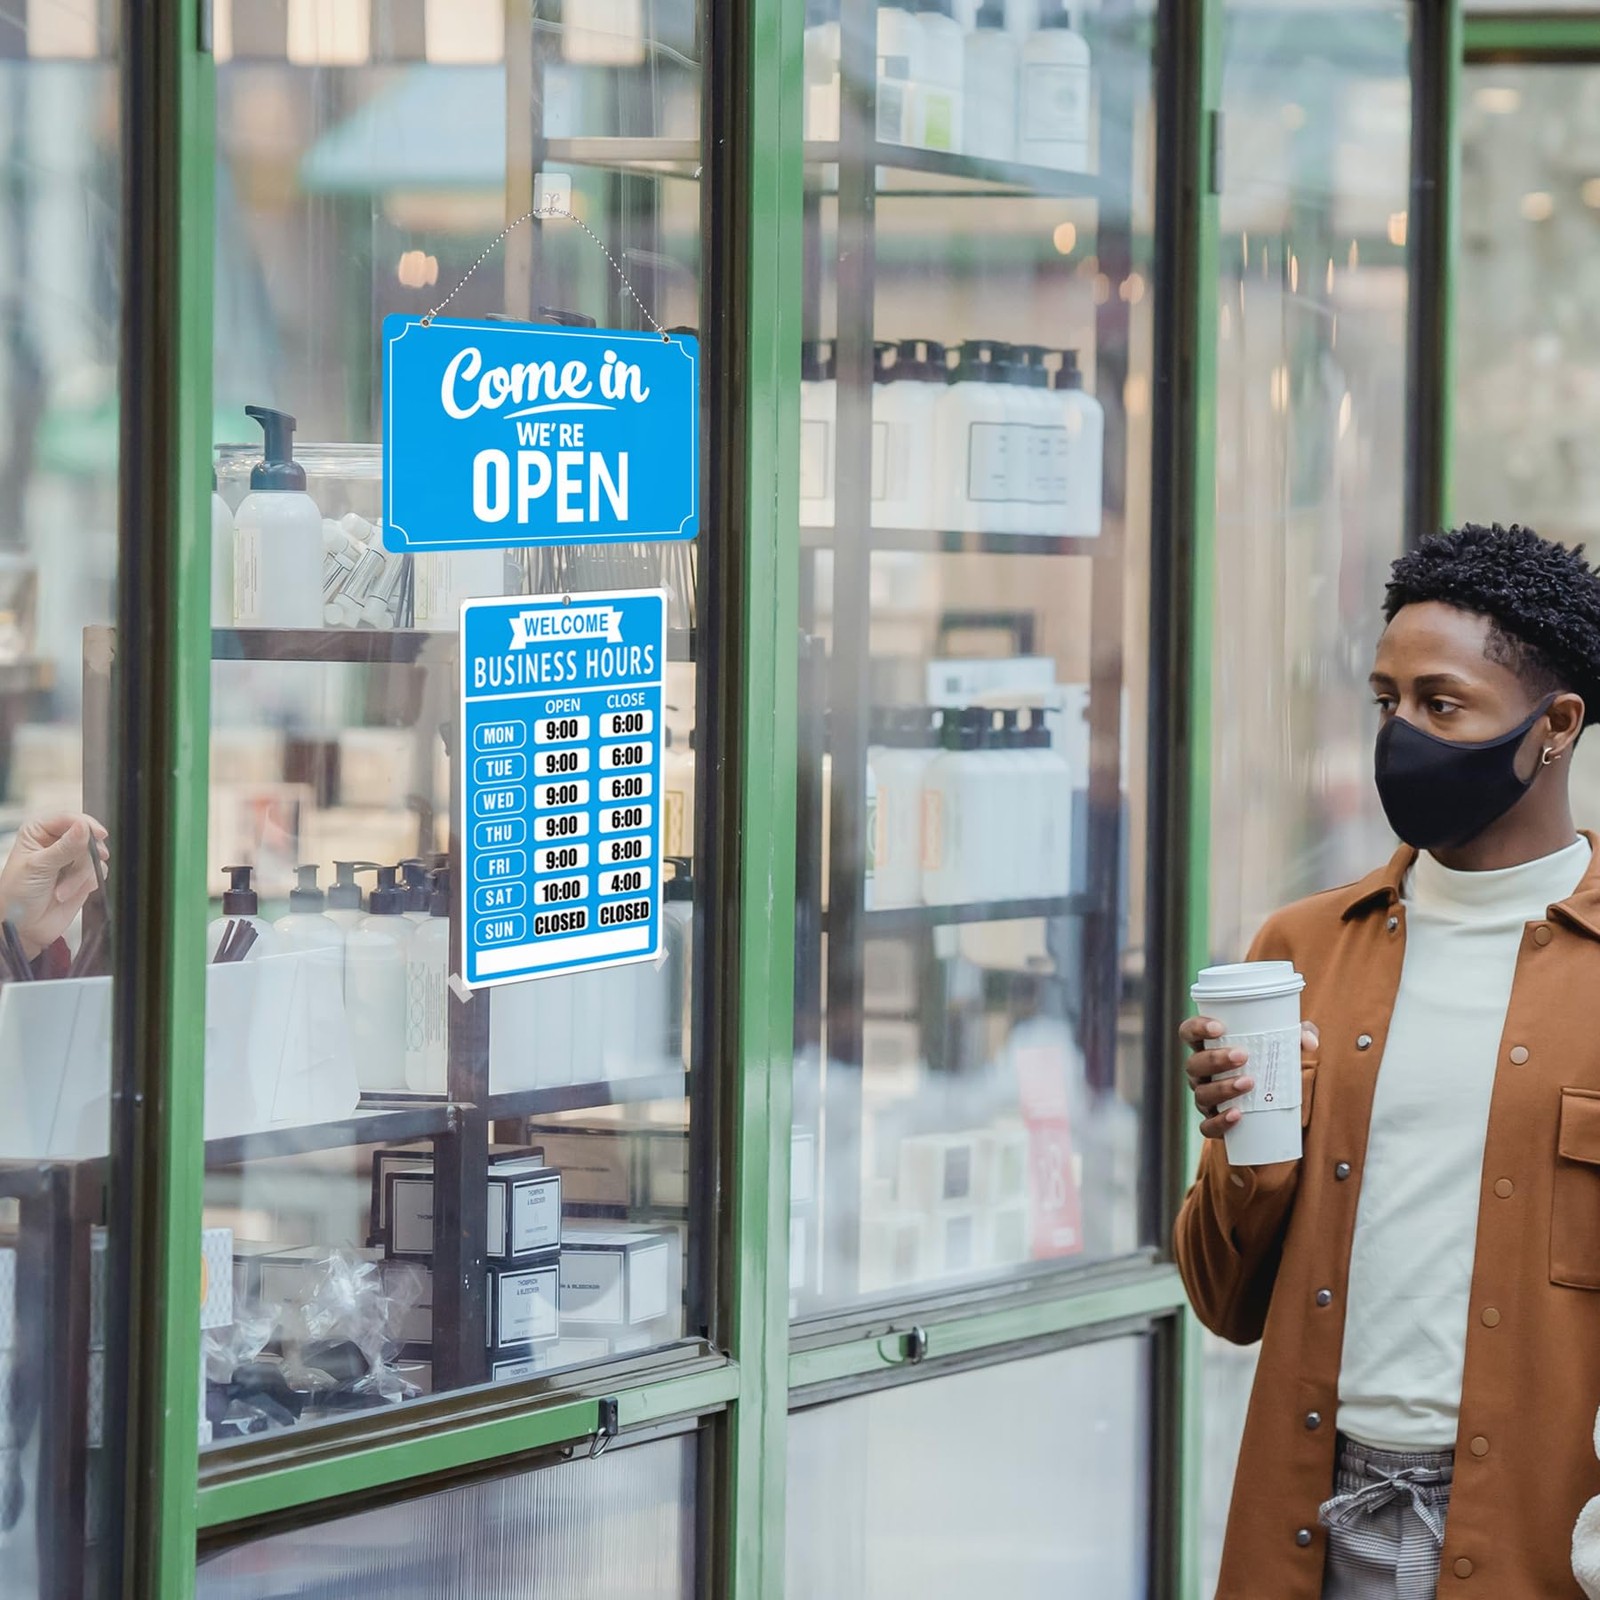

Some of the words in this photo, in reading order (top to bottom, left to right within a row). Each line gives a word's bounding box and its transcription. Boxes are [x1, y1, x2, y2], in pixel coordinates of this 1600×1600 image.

[441, 347, 593, 420] Come
[599, 349, 650, 403] in
[516, 422, 584, 447] WE'RE
[473, 448, 628, 524] OPEN
[524, 613, 609, 637] WELCOME
[474, 650, 577, 688] BUSINESS
[586, 644, 654, 679] HOURS
[545, 698, 581, 714] OPEN
[606, 692, 645, 709] CLOSE
[483, 726, 515, 744] MON
[546, 719, 578, 740] 9:00
[612, 713, 643, 734] 6:00
[485, 759, 513, 777] TUE
[546, 752, 578, 773] 9:00
[612, 745, 643, 766] 6:00
[482, 791, 514, 811] WED
[546, 784, 578, 806] 9:00
[612, 777, 643, 798] 6:00
[485, 824, 512, 843] THU
[546, 815, 578, 837] 9:00
[611, 807, 642, 829] 6:00
[488, 857, 511, 876] FRI
[546, 848, 578, 870] 9:00
[611, 839, 642, 861] 8:00
[484, 887, 513, 907] SAT
[542, 880, 581, 902] 10:00
[611, 871, 641, 893] 4:00
[484, 920, 514, 940] SUN
[534, 910, 586, 935] CLOSED
[600, 900, 649, 925] CLOSED
